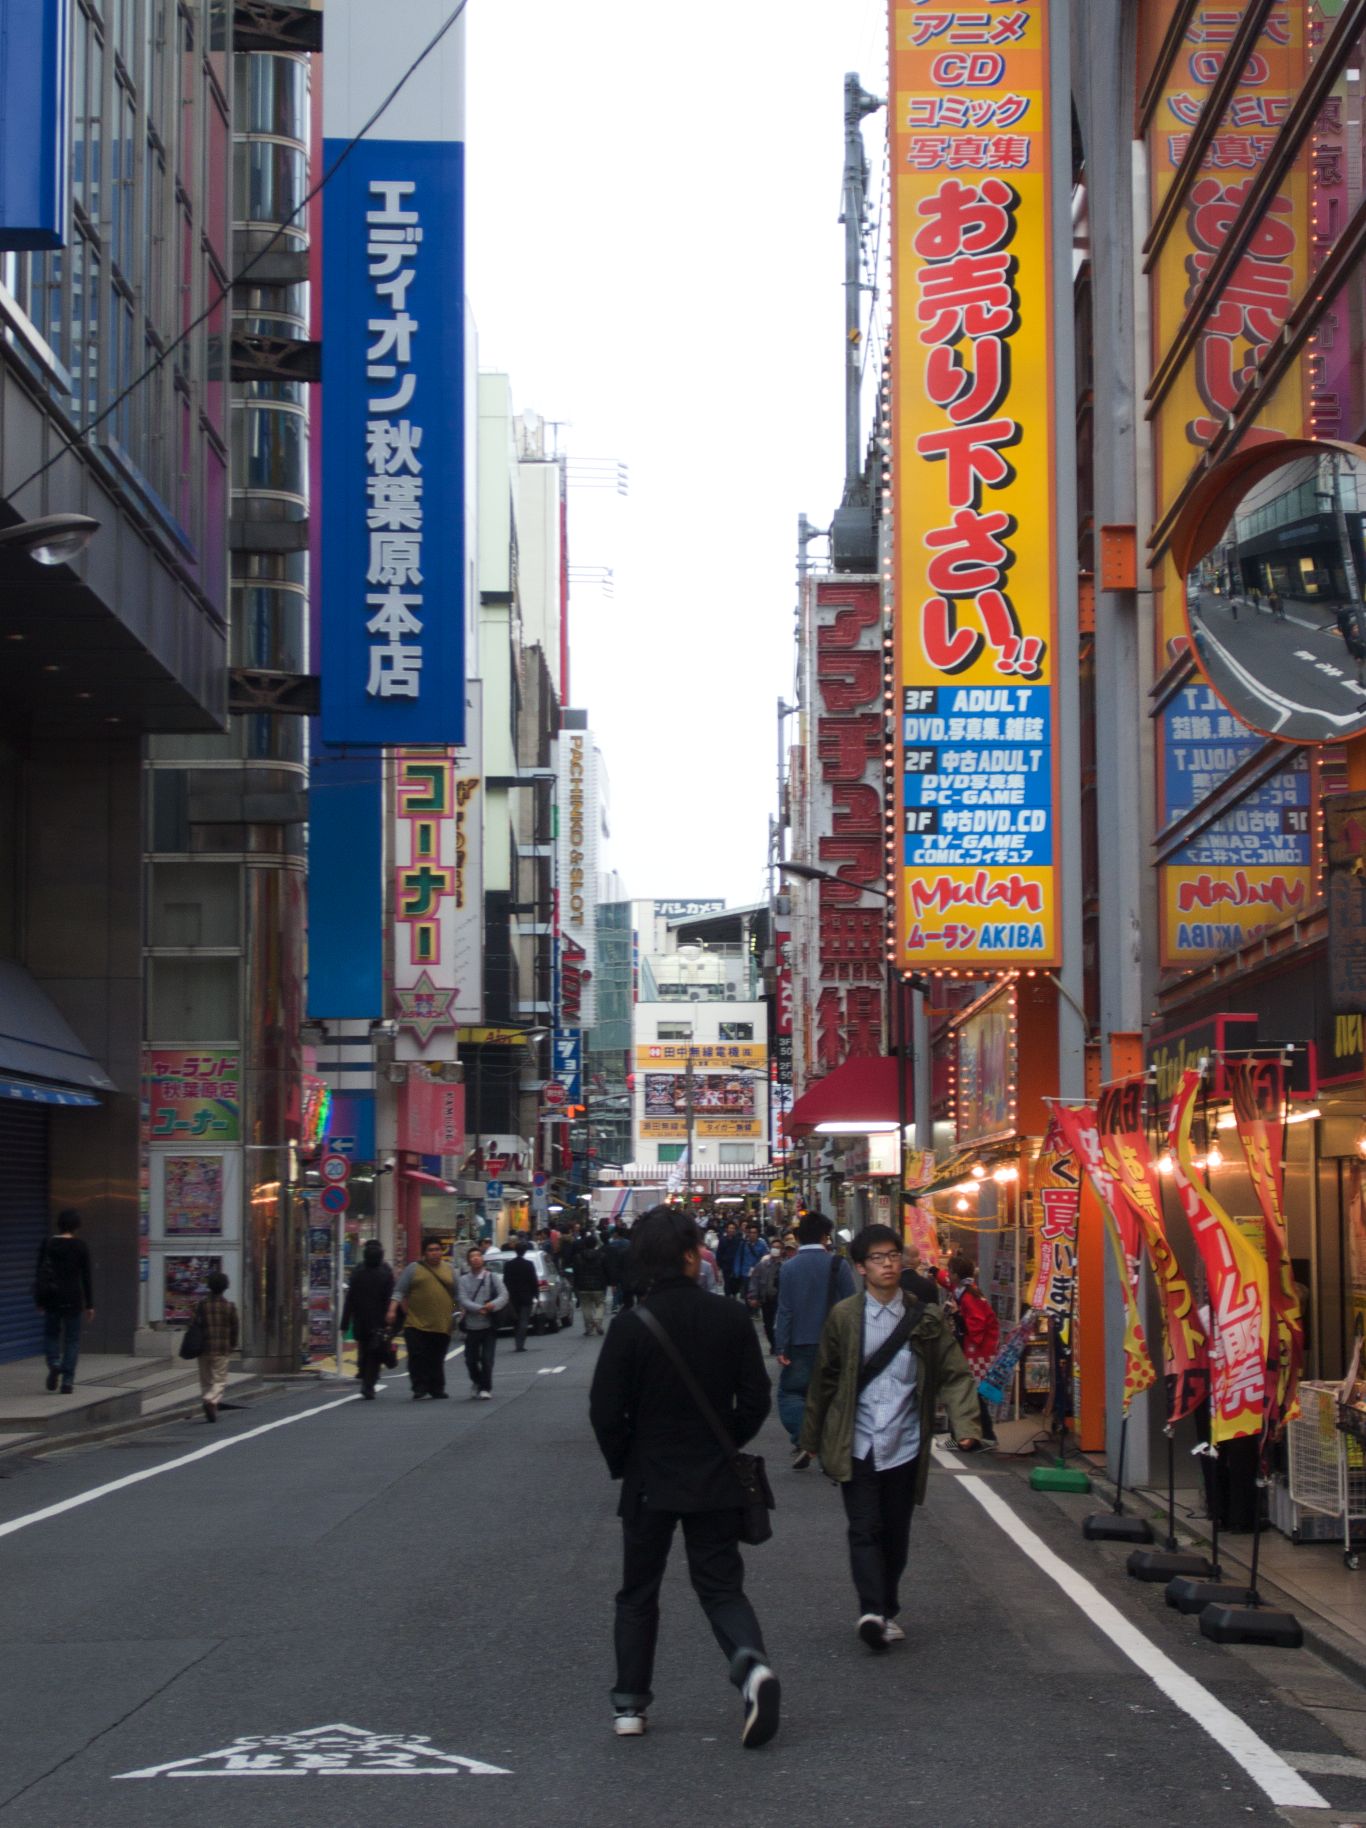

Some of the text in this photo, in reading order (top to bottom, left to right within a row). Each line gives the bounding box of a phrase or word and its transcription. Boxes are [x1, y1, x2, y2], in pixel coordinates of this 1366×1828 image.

[910, 11, 1029, 46] アニメ
[930, 52, 1004, 86] CD
[907, 93, 1031, 129] コミック
[907, 135, 1030, 169] 写真集
[905, 690, 1032, 712] 3F ADULT
[905, 749, 1042, 775] 2F 中古ADULT
[921, 774, 1026, 789] DVD写真集
[920, 790, 1025, 805] PC-GAME
[570, 736, 584, 927] PACHINKO & SLOT
[906, 808, 1047, 833] 1F 中古DVD.CD
[921, 834, 1027, 849] TV-GAME
[909, 870, 1044, 919] Mulan
[907, 922, 1045, 951] ムーラン AKIBA
[153, 1108, 229, 1134] コーナー
[326, 1161, 344, 1177] 20
